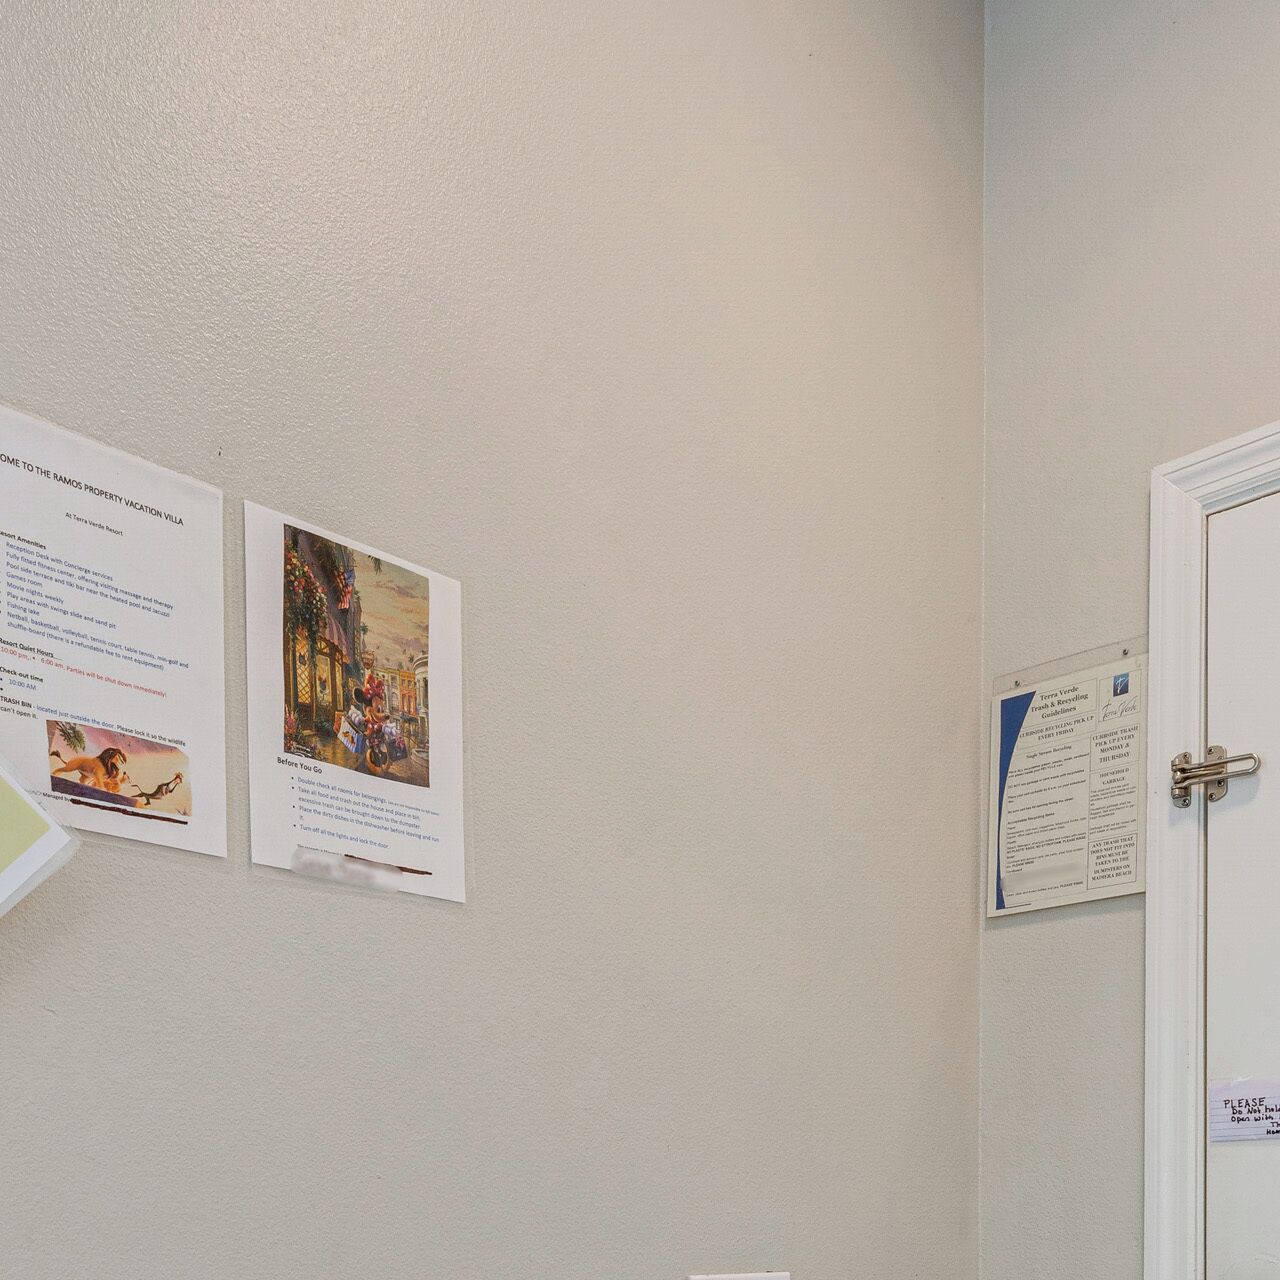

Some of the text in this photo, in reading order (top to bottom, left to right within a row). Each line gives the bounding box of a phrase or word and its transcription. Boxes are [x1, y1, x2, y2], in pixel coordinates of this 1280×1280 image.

[22, 461, 34, 472] TO
[35, 466, 51, 479] THE
[53, 473, 82, 490] RAMOS
[84, 484, 123, 504] PROPERTY
[124, 498, 162, 518] VACATION
[163, 512, 184, 526] VILLA
[73, 514, 88, 524] Terra
[88, 520, 105, 530] Verde
[106, 525, 123, 536] Resort
[17, 536, 46, 550] Amenities
[6, 541, 35, 556] Reception
[36, 551, 49, 560] Desk
[64, 561, 91, 574] Concierge
[92, 571, 113, 581] services
[6, 571, 43, 588] Games room
[7, 581, 64, 604] Movie nights weekly
[7, 601, 40, 616] Fishing lake
[19, 643, 35, 653] Quiet
[36, 648, 54, 658] Hours
[0, 666, 29, 679] Check-out
[30, 675, 43, 683] time
[9, 678, 25, 688] 10:00
[1040, 686, 1079, 701] Terra Verde
[0, 706, 15, 714] can't
[1031, 703, 1048, 712] Trash
[1057, 694, 1088, 706] Recycling
[1041, 707, 1076, 719] Guidelines
[0, 695, 20, 705] TRASH
[36, 705, 57, 715] located
[58, 710, 69, 718] just
[70, 714, 90, 723] outside
[117, 724, 133, 734] Please
[168, 739, 186, 747] wildlife
[277, 756, 322, 774] Before You Go
[1099, 752, 1129, 763] THURSDAY
[42, 792, 63, 800] Managed
[300, 824, 312, 832] Turn
[1223, 1097, 1266, 1109] PLEASE
[1231, 1107, 1242, 1115] Do
[1247, 1105, 1261, 1114] Not
[1231, 1116, 1250, 1124] Open
[1254, 1113, 1273, 1121] with
